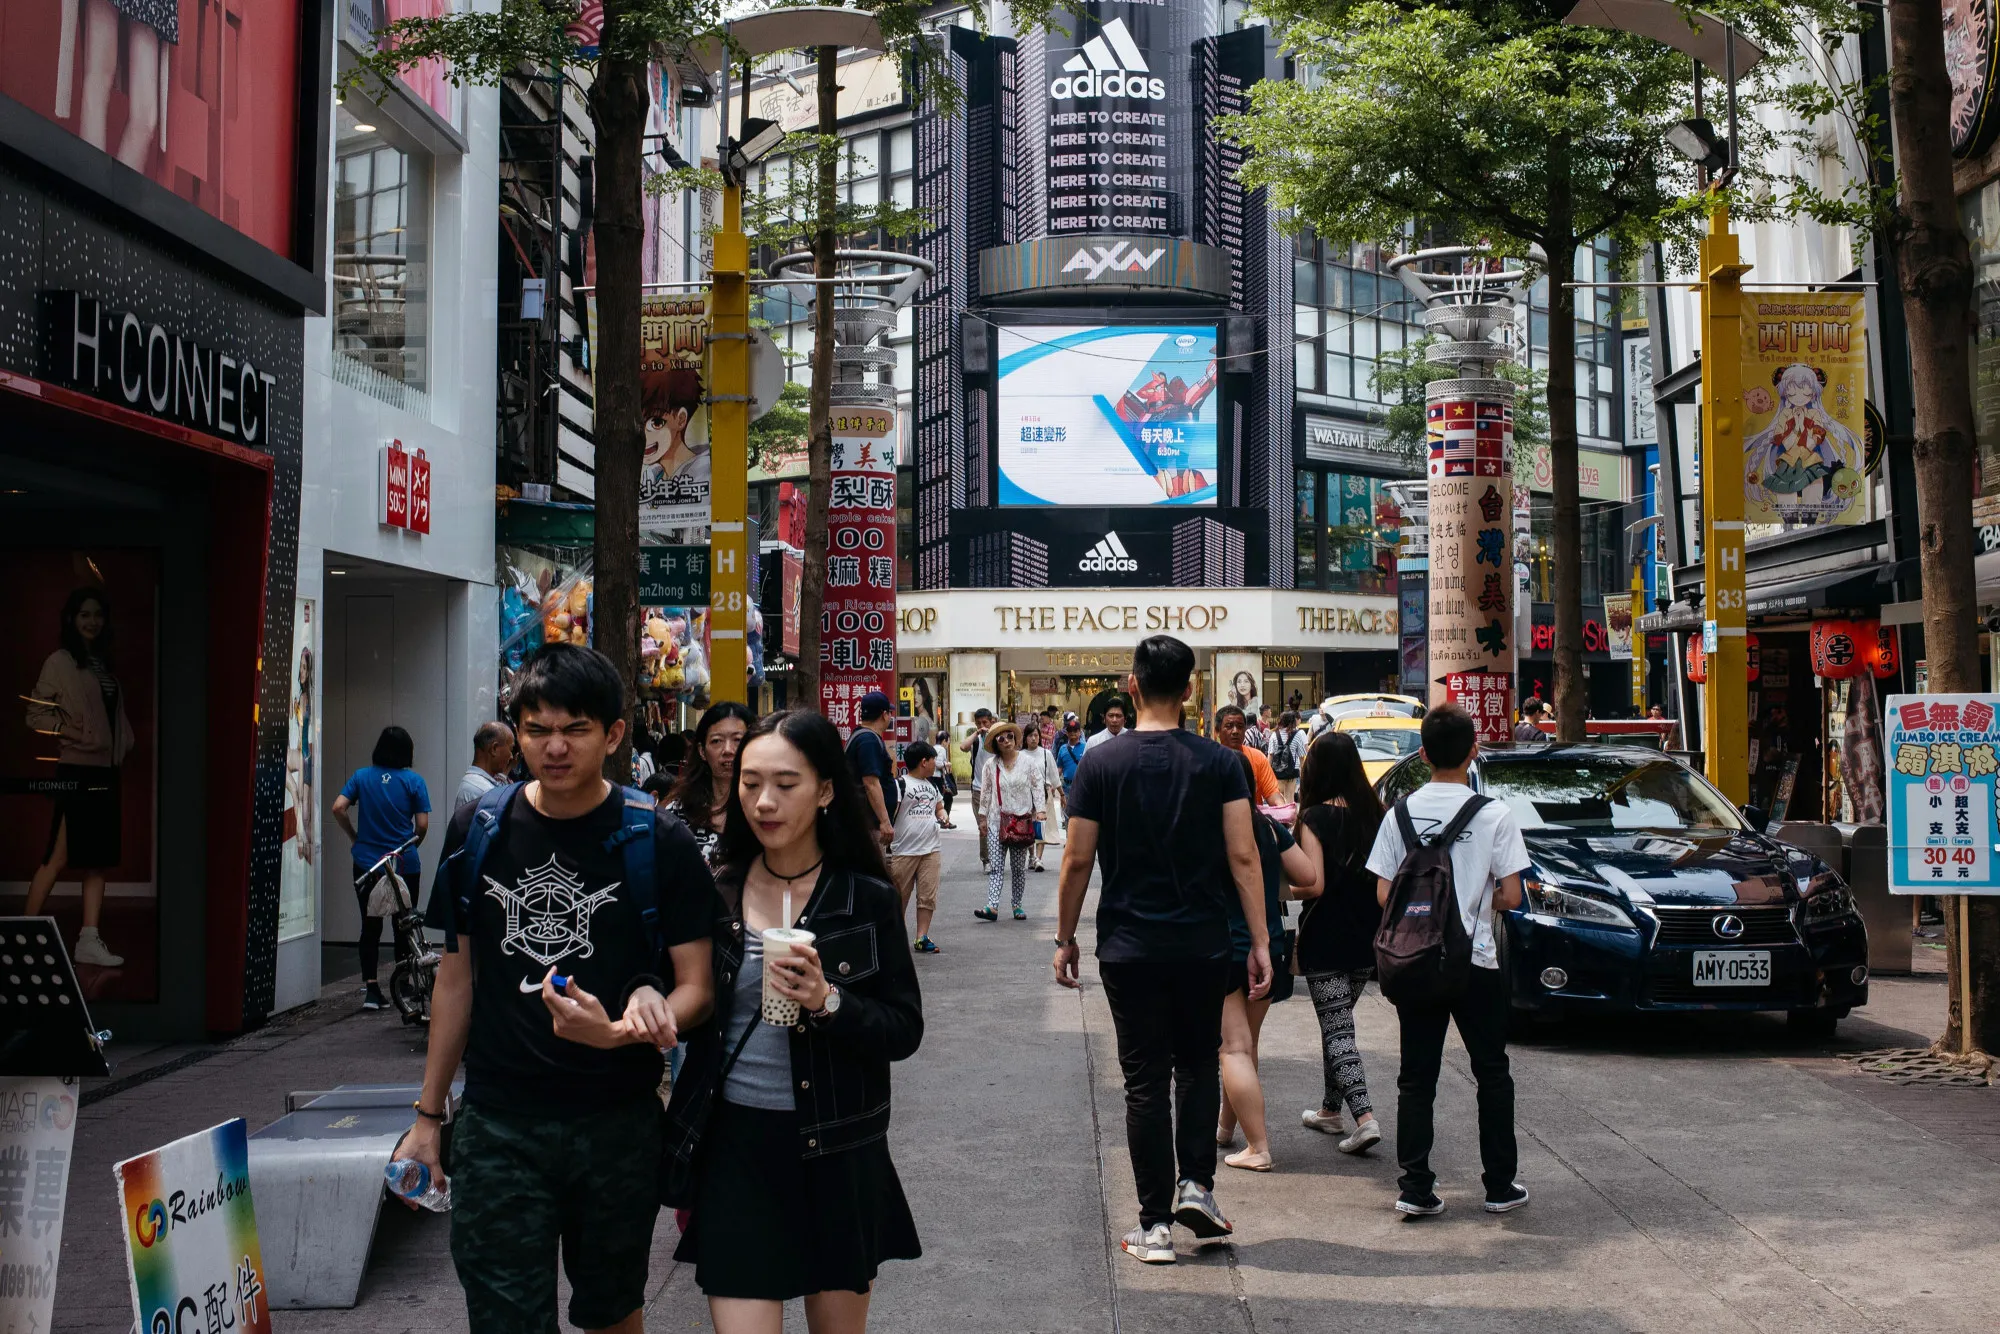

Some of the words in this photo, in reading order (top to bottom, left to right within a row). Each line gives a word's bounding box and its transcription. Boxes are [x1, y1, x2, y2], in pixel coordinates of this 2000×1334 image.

[1050, 69, 1166, 100] adidas
[1050, 112, 1086, 126] HERE
[1089, 112, 1109, 124] TO
[1112, 112, 1166, 126] CREATE
[1050, 132, 1086, 147] HERE
[1089, 132, 1109, 144] TO
[1112, 132, 1166, 147] CREATE
[1050, 154, 1086, 168] HERE
[1089, 153, 1109, 165] TO
[1112, 153, 1166, 168] CREATE
[1050, 174, 1086, 188] HERE
[1089, 174, 1109, 186] TO
[1112, 174, 1166, 188] CREATE
[1050, 195, 1086, 209] HERE
[1089, 194, 1109, 206] TO
[1112, 194, 1166, 209] CREATE
[1050, 216, 1086, 230] HERE
[1089, 216, 1109, 227] TO
[1112, 216, 1166, 230] CREATE
[1060, 241, 1166, 280] AXN
[1758, 321, 1851, 353] 西門町
[73, 292, 277, 445] H:CONNECT
[651, 362, 664, 371] to
[1020, 426, 1066, 442] 超速變形
[1314, 428, 1364, 448] WATAMI
[390, 464, 406, 488] MINI
[830, 476, 893, 509] 梨酥
[826, 528, 884, 550] 00
[717, 550, 734, 574] H
[1079, 556, 1138, 572] adidas
[1722, 548, 1738, 571] H
[640, 584, 684, 599] anZhong
[1716, 589, 1742, 610] 33
[712, 592, 742, 612] 28
[844, 600, 873, 610] Rice
[994, 606, 1056, 631] THE
[1063, 606, 1139, 632] FACE
[1146, 605, 1228, 631] SHOP
[1296, 606, 1336, 632] THE
[1336, 608, 1382, 634] FACE
[1046, 653, 1080, 666] THE
[1081, 652, 1121, 666] FACE
[1450, 676, 1507, 691] 台灣美味
[1899, 700, 1994, 732] 巨無霸
[1894, 732, 1936, 744] JUMBO
[1938, 732, 1956, 743] ICE
[1895, 742, 2000, 778] 霜淇淋
[1955, 796, 1969, 835] 超大支
[1924, 848, 1947, 864] 30
[1952, 848, 1976, 864] 40
[1932, 867, 1942, 878] 元
[1958, 867, 1969, 878] 元
[168, 1172, 247, 1230] Rainbow
